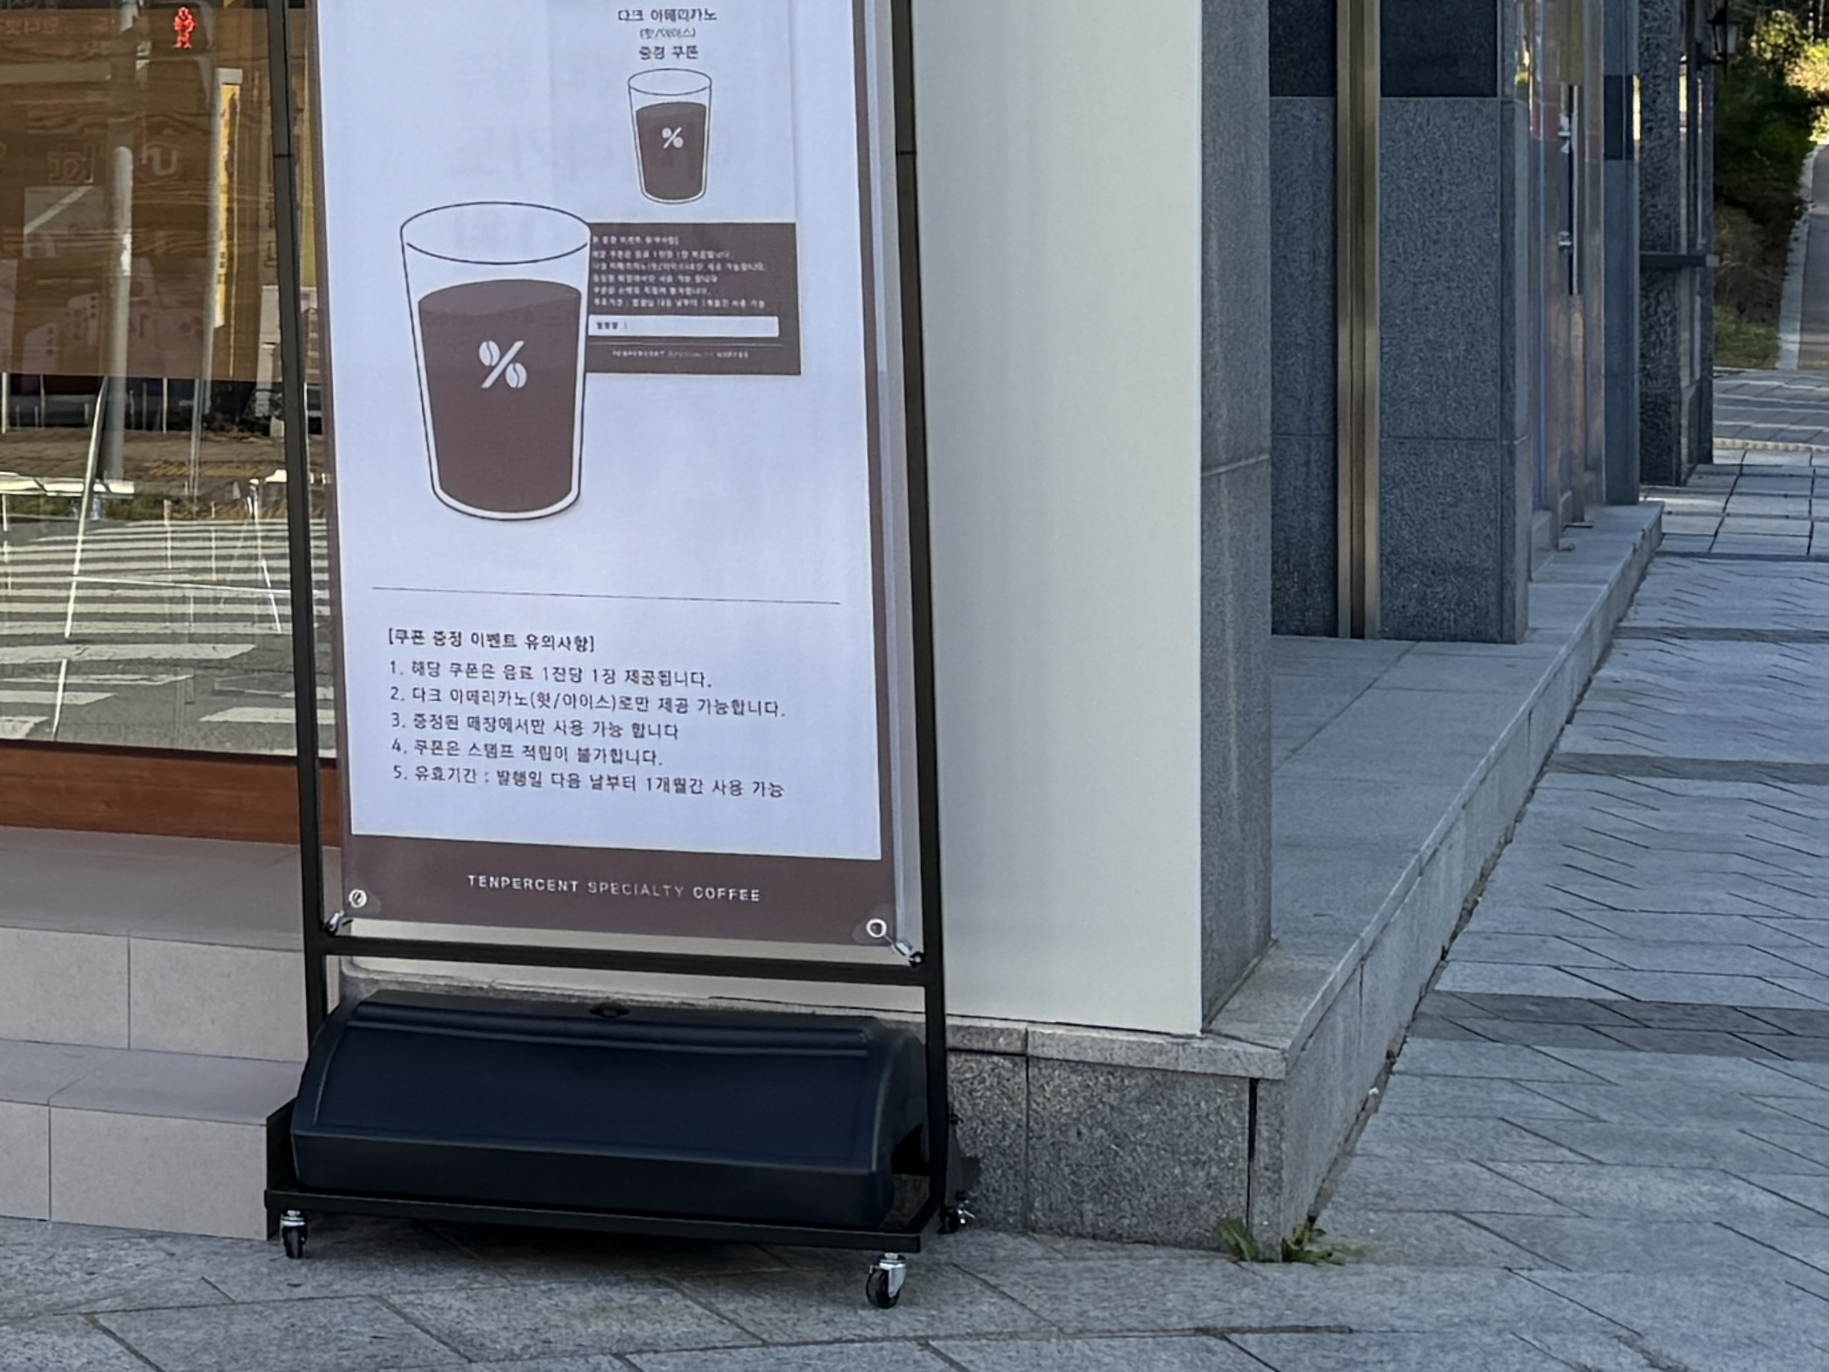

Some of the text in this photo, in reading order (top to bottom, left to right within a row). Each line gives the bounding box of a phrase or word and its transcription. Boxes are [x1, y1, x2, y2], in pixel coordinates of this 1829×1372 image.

[388, 627, 426, 646] [쿠폰
[433, 630, 463, 647] 증정
[471, 631, 518, 649] 이벤트
[389, 660, 404, 676] 1.
[411, 661, 441, 678] 해당
[449, 662, 495, 680] 쿠폰은
[503, 664, 534, 681] 음료
[390, 686, 405, 702] 2.
[412, 687, 442, 703] 다크
[657, 697, 689, 714] 제공
[696, 697, 786, 717] 가능합니다.
[391, 712, 406, 729] 3.
[553, 719, 584, 737] 사용
[592, 719, 623, 739] 가능
[632, 722, 679, 740] 합니다
[391, 738, 407, 755] 4.
[413, 739, 460, 757] 쿠폰은
[577, 746, 663, 767] 불가합니다.
[393, 765, 408, 781] 5.
[414, 766, 478, 785] 유효기간
[496, 770, 543, 789] 발행일
[551, 772, 582, 790] 다음
[590, 773, 637, 793] 날부터
[646, 776, 704, 796] 1개월간
[712, 779, 745, 798] 사용
[752, 780, 785, 799] 가능
[466, 873, 761, 903] TENPERCENT SPECIALTY COFFEE
